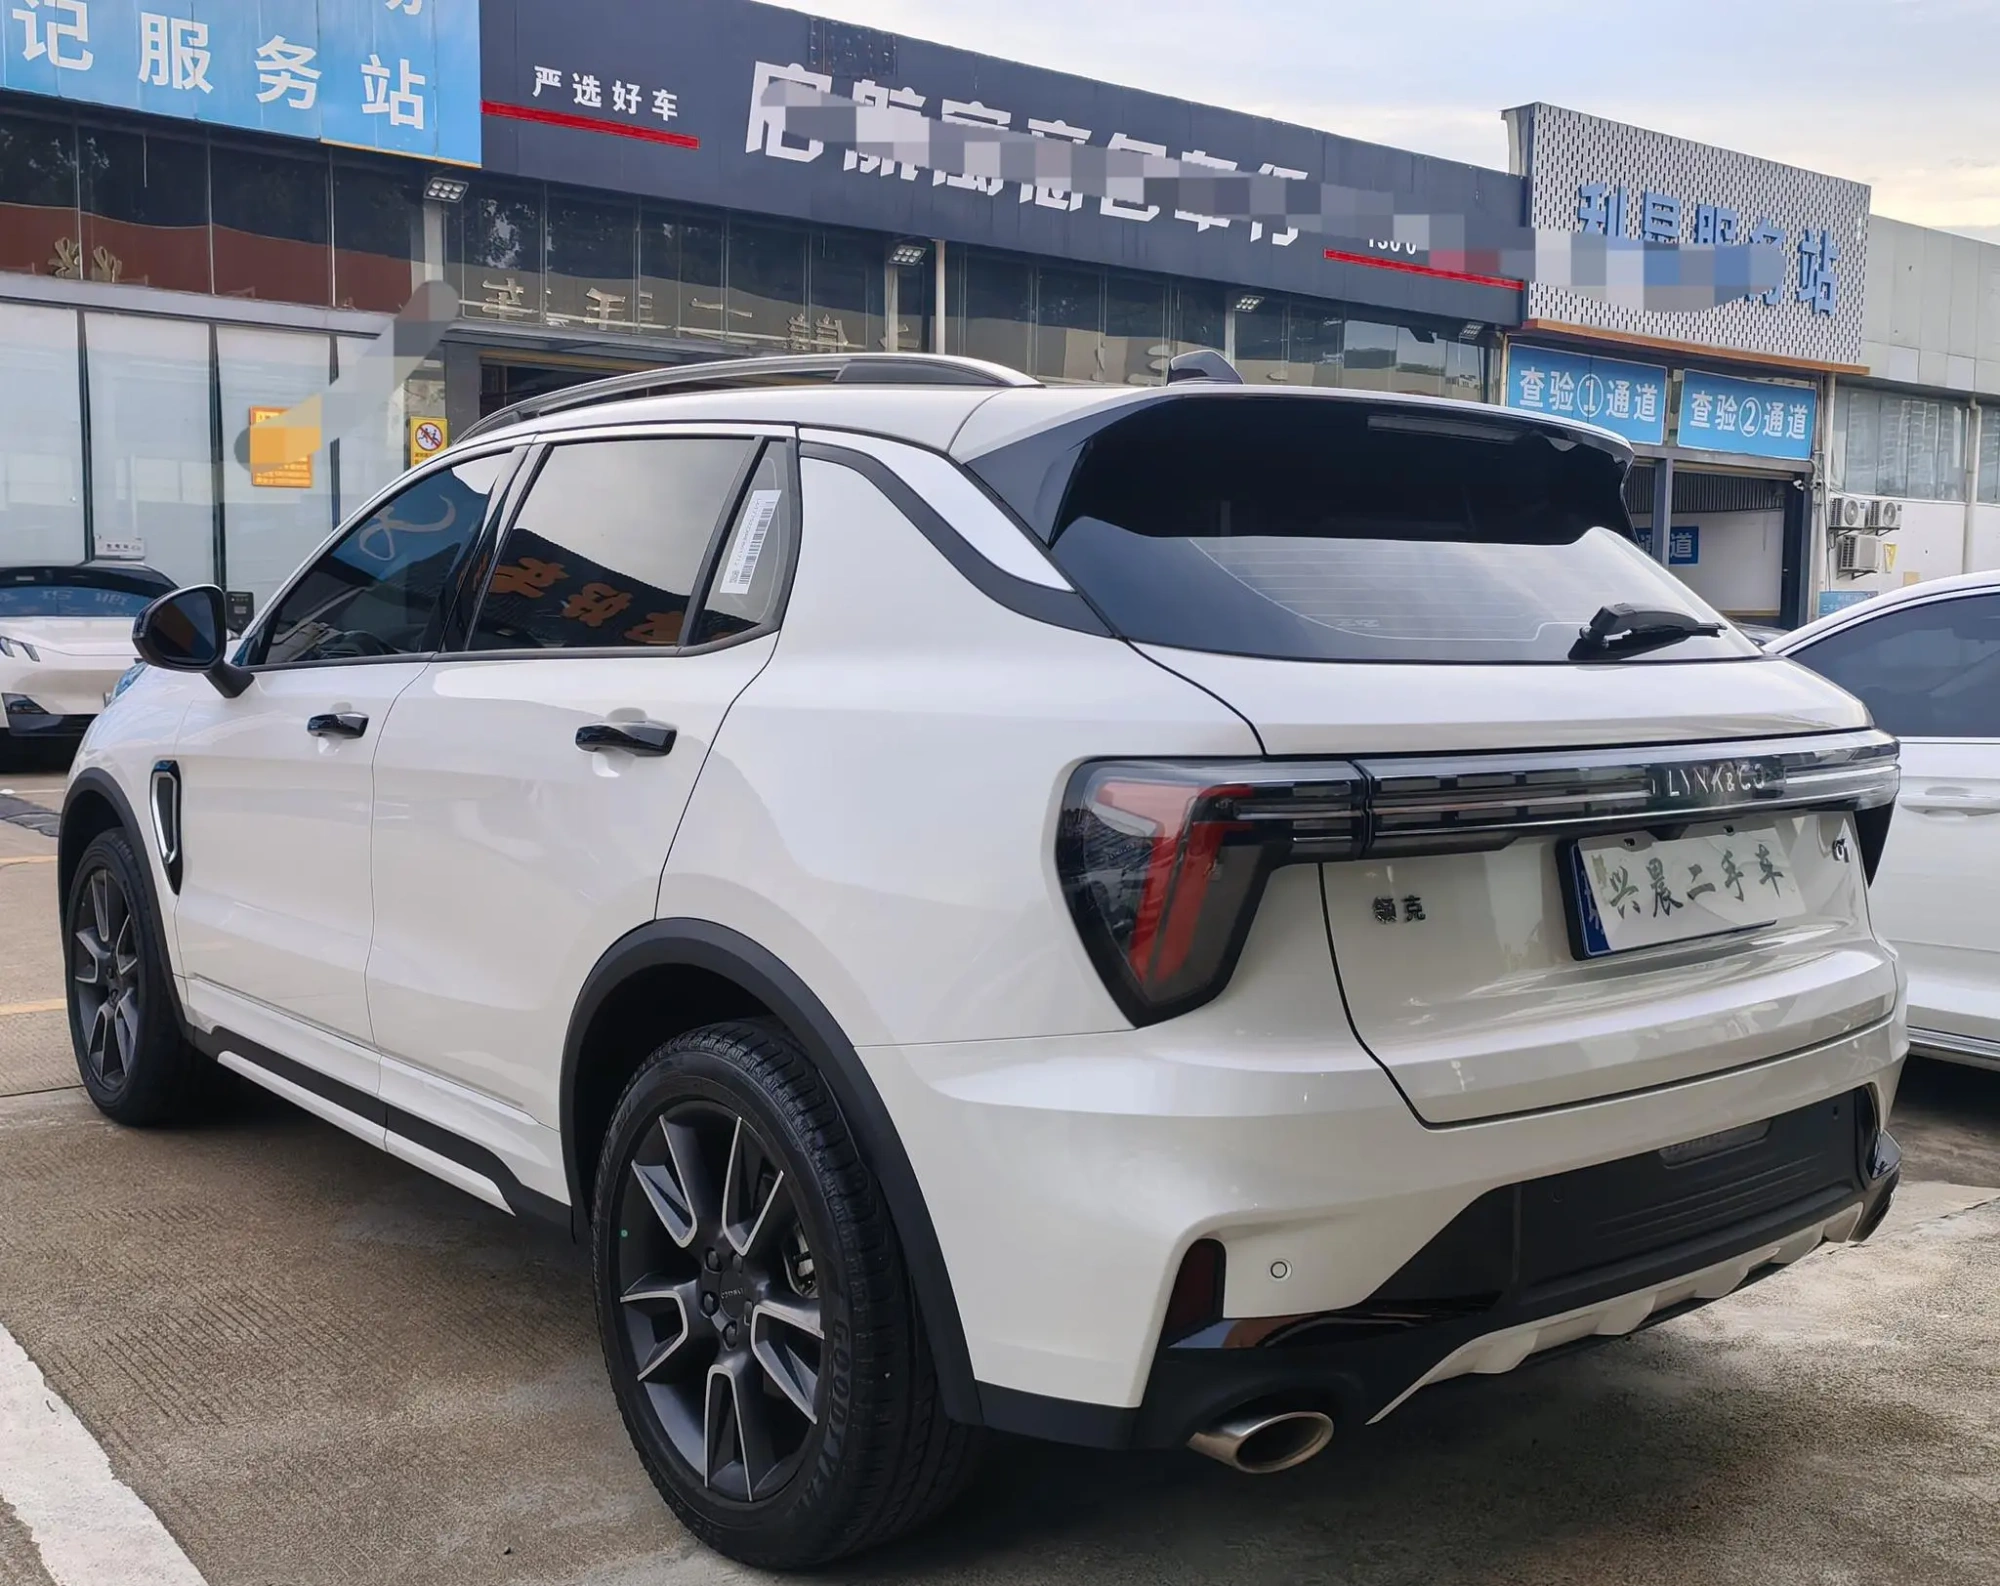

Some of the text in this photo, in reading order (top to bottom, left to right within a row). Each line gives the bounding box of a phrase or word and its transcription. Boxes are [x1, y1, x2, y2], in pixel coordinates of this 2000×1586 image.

[12, 0, 426, 130] 记服务站
[532, 65, 678, 122] 严选好车
[1609, 843, 1784, 919] 兴晨二手车
